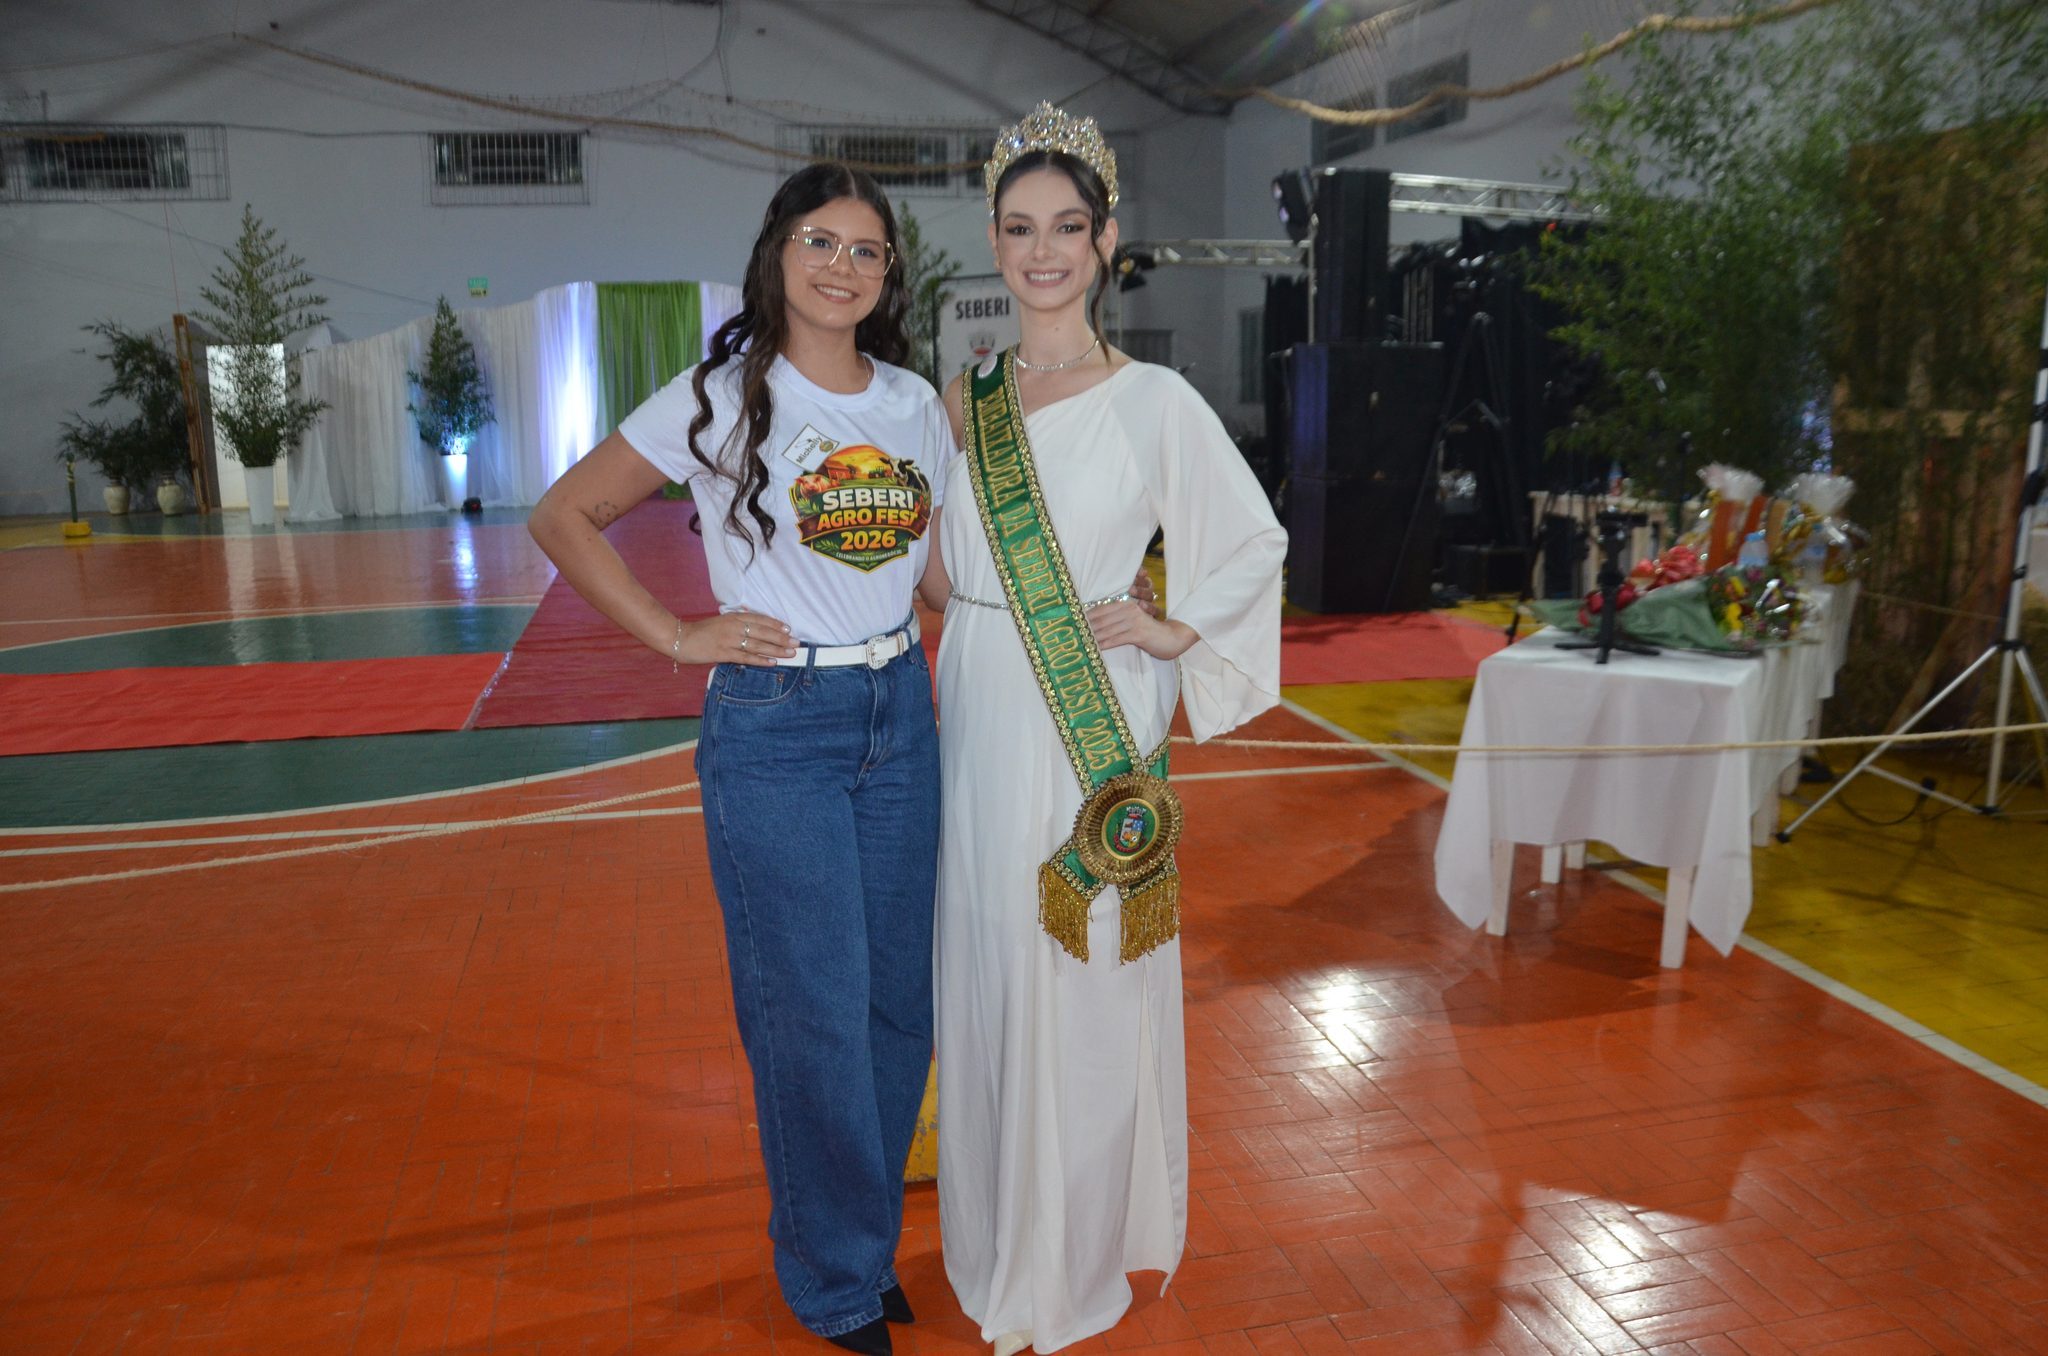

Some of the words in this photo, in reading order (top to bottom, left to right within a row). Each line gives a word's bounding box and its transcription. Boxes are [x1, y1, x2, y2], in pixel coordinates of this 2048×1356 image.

[955, 296, 1010, 320] SEBERI
[823, 487, 914, 511] SEBERI
[817, 508, 872, 531] AGRO
[876, 508, 918, 527] FEST
[998, 502, 1035, 539] DA
[840, 530, 896, 551] 2026
[1008, 535, 1064, 614] SEBERI
[1034, 616, 1085, 670] AGRO
[1055, 665, 1104, 719] FEST
[1075, 718, 1124, 771] 2025
